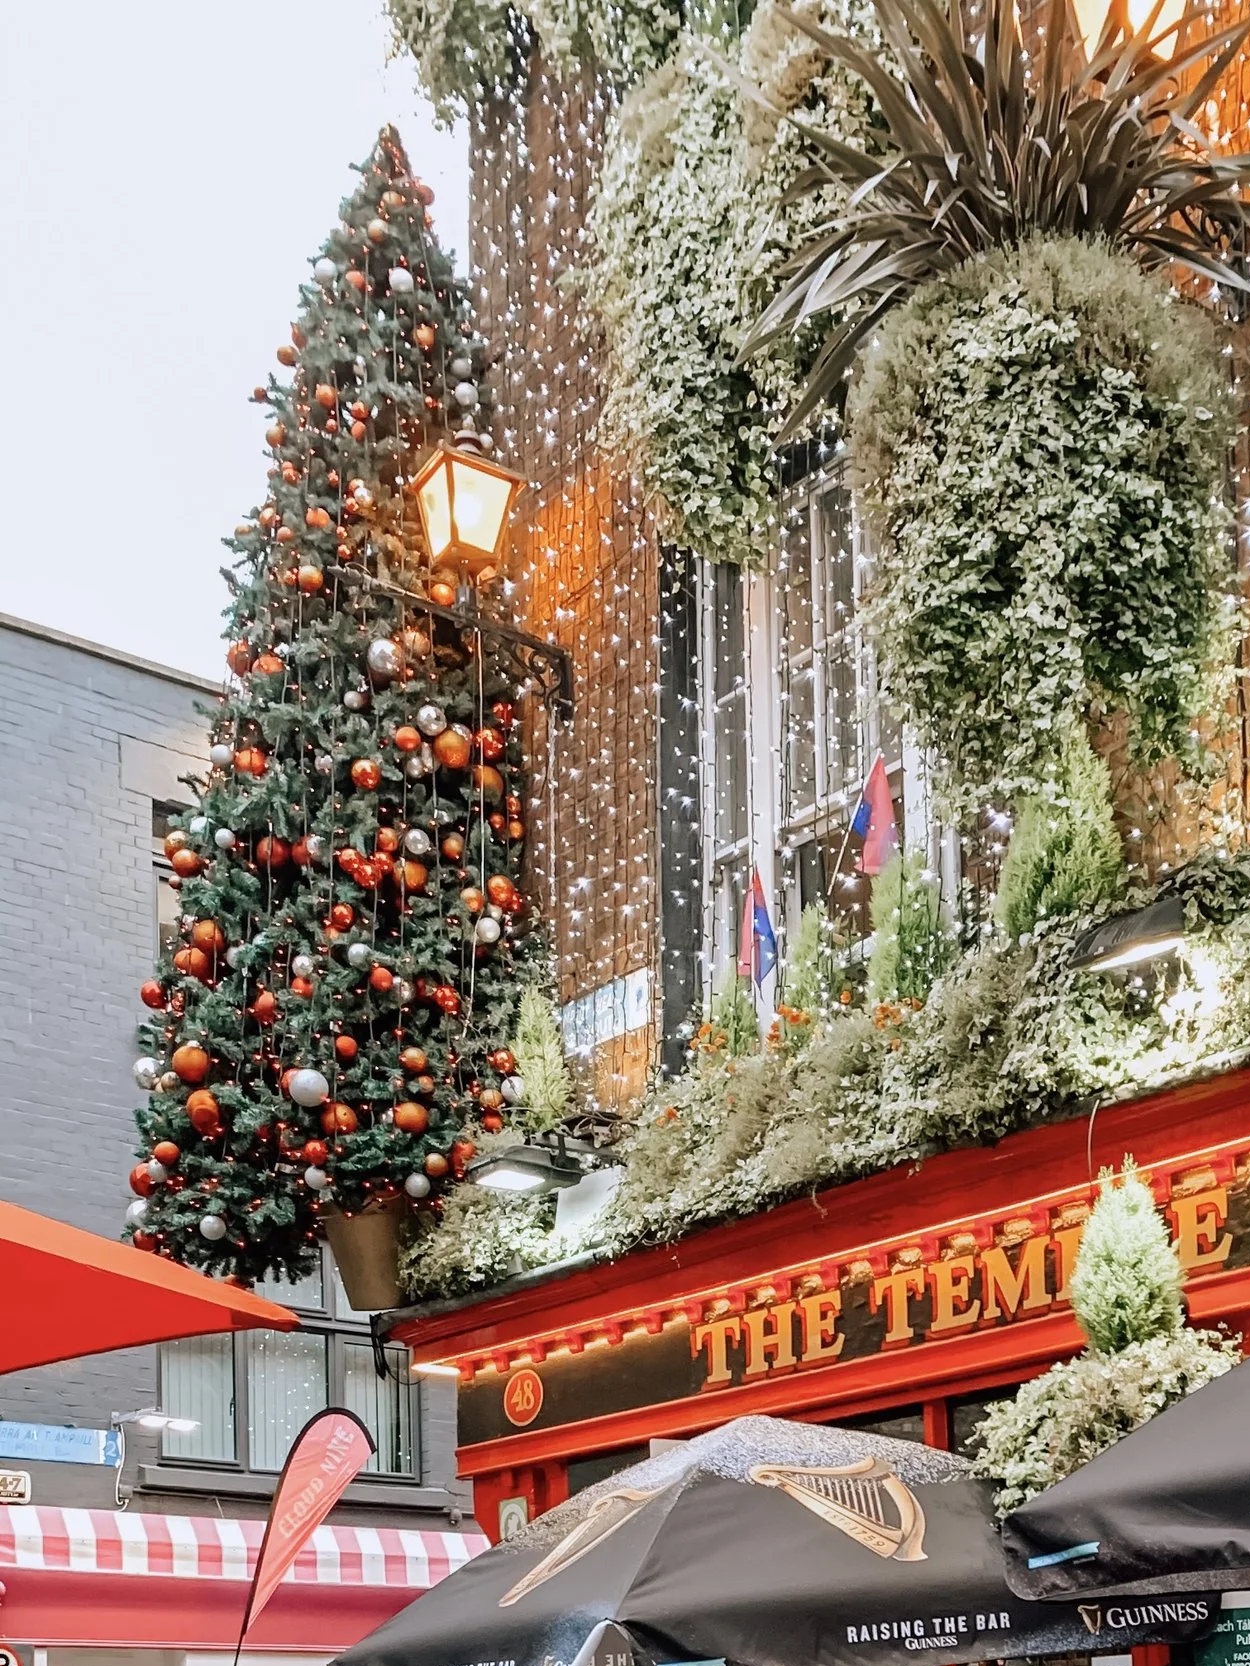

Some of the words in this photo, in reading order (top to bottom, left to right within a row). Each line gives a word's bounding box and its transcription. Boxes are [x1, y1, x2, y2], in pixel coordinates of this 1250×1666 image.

[692, 1290, 846, 1386] THE
[873, 1188, 1233, 1343] TEME
[511, 1379, 535, 1412] 48
[105, 1441, 117, 1458] 2
[279, 1477, 324, 1538] CLOUD
[320, 1426, 355, 1476] NINE
[847, 1620, 924, 1643] RAISING
[932, 1616, 968, 1634] THE
[976, 1612, 1011, 1630] BAR
[1106, 1601, 1209, 1629] GUINNESS
[905, 1635, 959, 1650] GUINNESS
